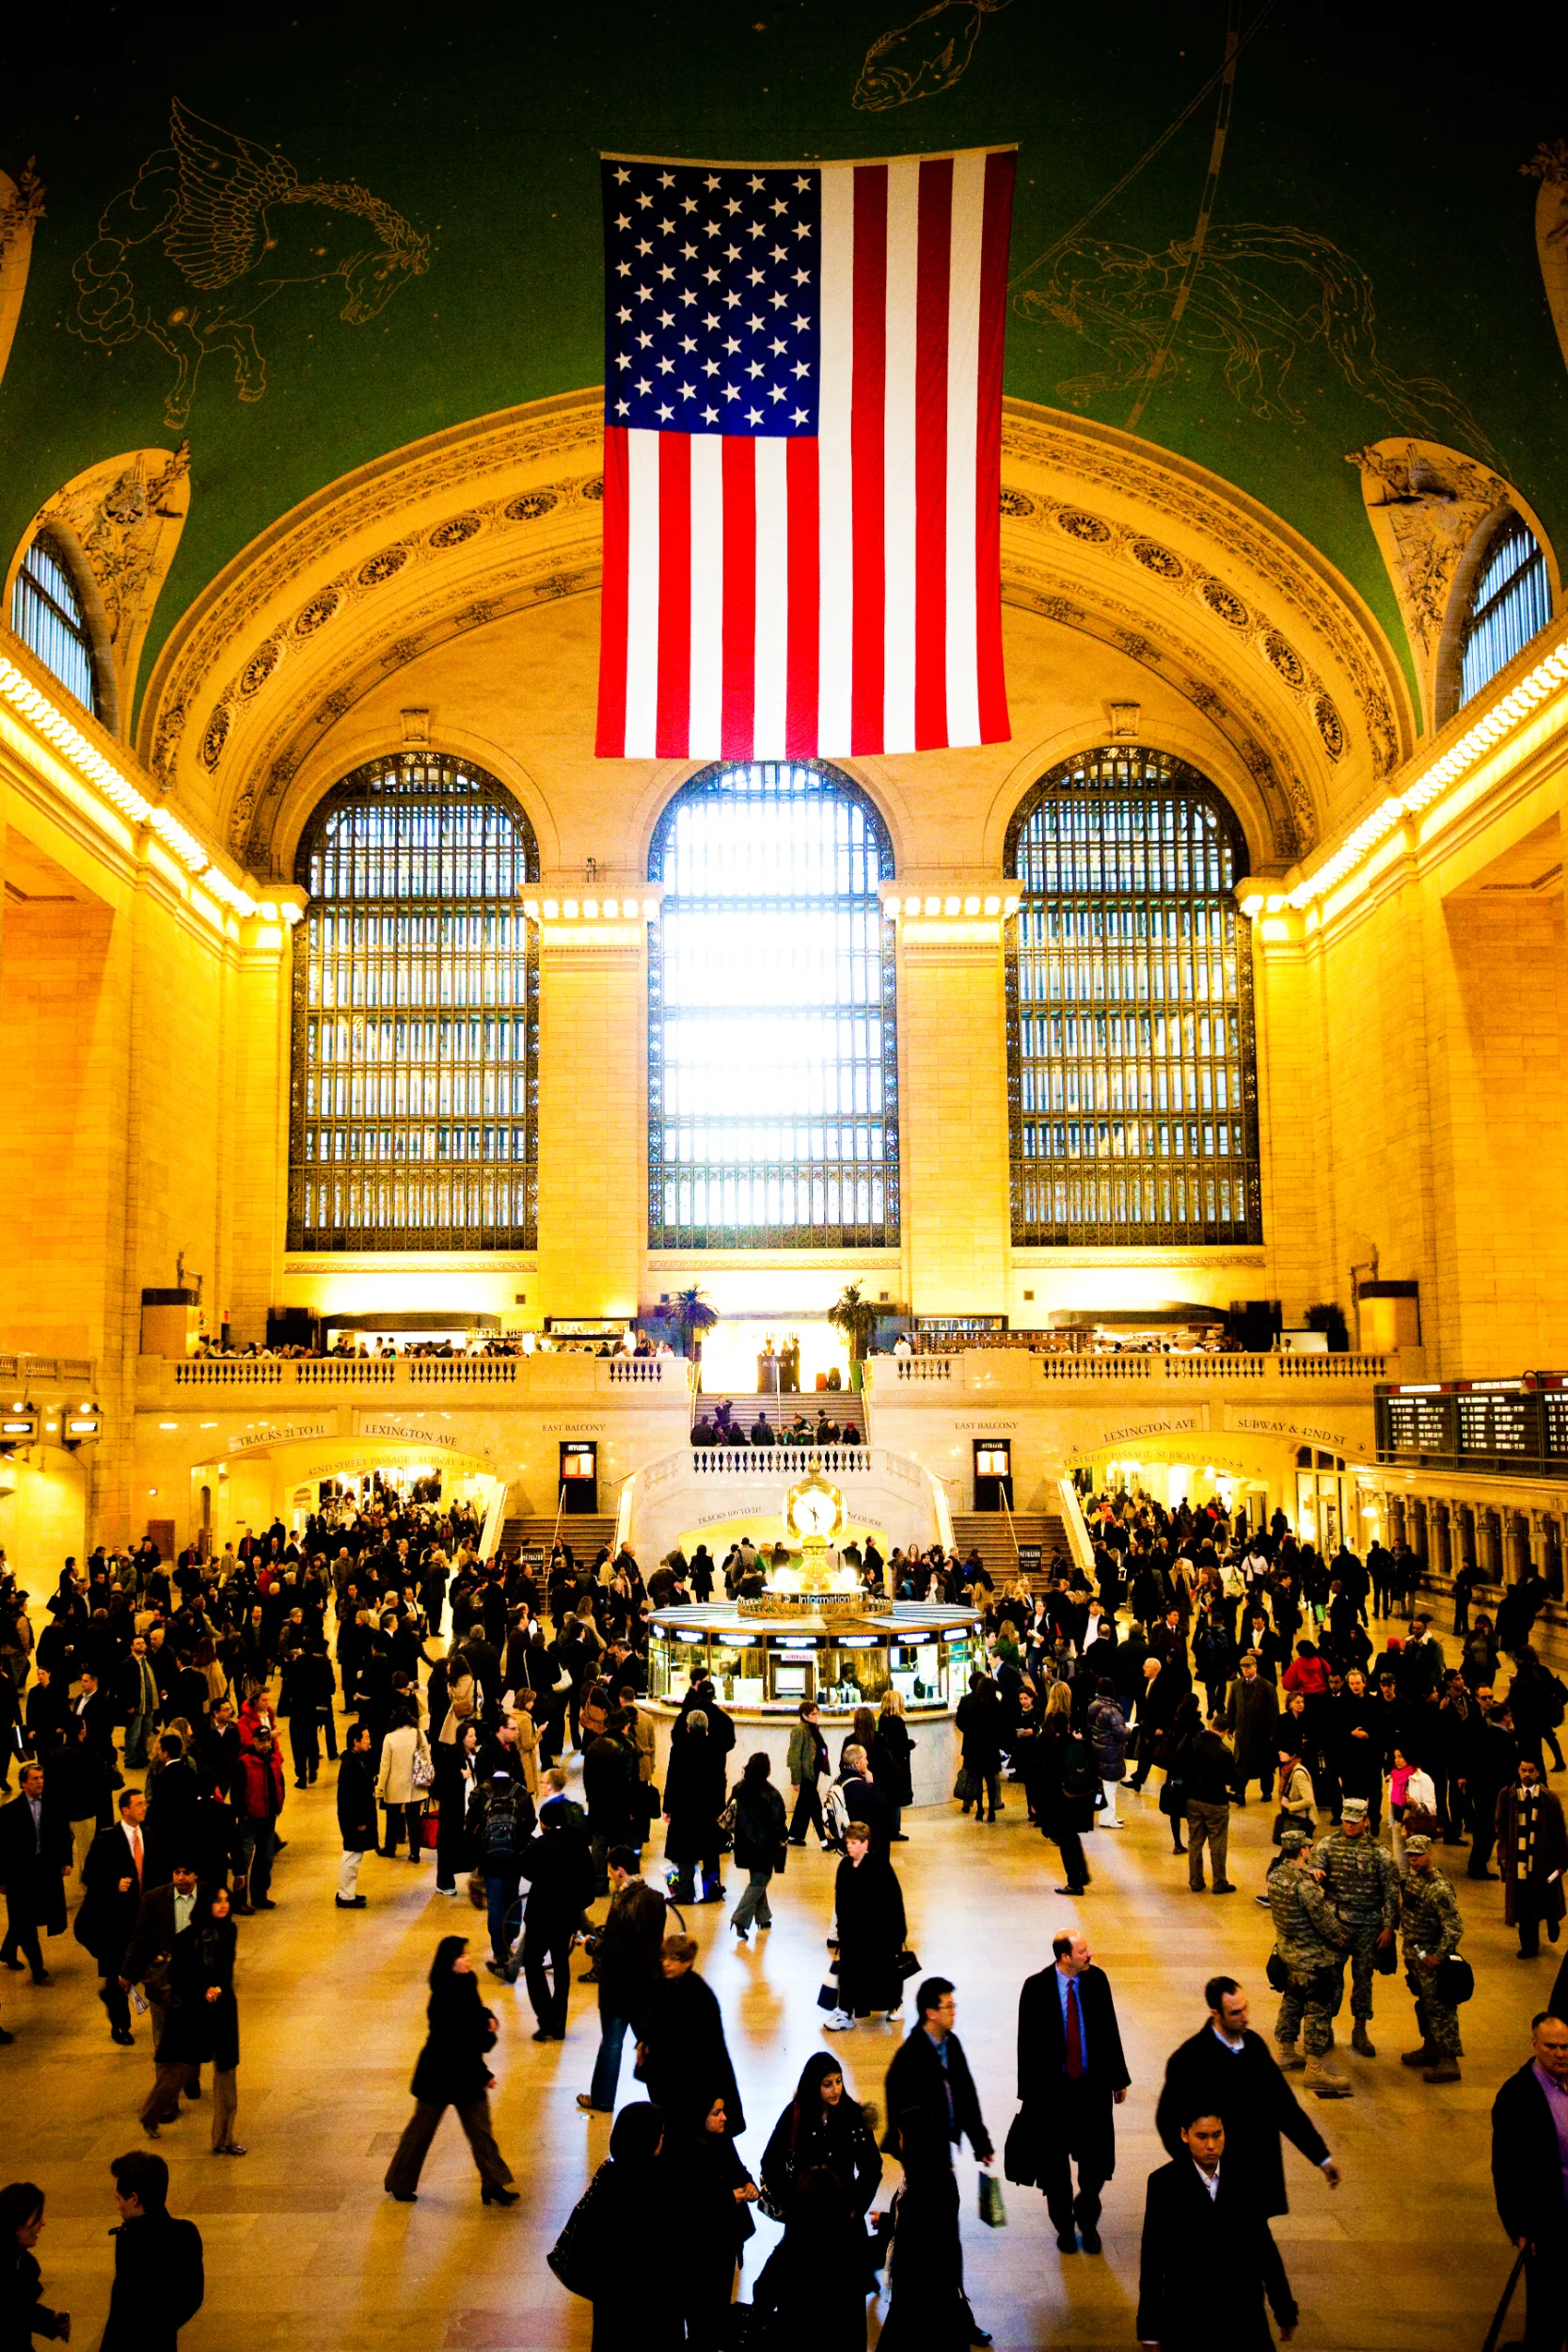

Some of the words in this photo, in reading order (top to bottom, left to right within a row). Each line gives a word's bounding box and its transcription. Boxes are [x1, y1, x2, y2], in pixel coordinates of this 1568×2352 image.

[365, 1423, 433, 1441] LEXINGTON
[436, 1435, 457, 1446] AVE
[542, 1423, 562, 1432] EAST
[565, 1423, 606, 1432] BALCONY
[955, 1422, 975, 1430] EAST
[978, 1422, 1019, 1430] BALCONY
[1103, 1421, 1172, 1442] LEXINGTON
[1176, 1419, 1196, 1429] AVE
[1238, 1419, 1286, 1431] SUBWAY
[1289, 1424, 1298, 1434] &
[1301, 1427, 1331, 1441] 42ND
[1334, 1435, 1347, 1445] ST
[238, 1429, 282, 1446] TRACKS
[285, 1428, 294, 1438] 21
[297, 1425, 313, 1436] TO
[316, 1424, 325, 1434] 11
[309, 1464, 333, 1475] 42ND
[334, 1458, 368, 1469] STREET
[371, 1455, 410, 1465] PASSAGE
[418, 1455, 456, 1466] SUBWAY
[1073, 1452, 1108, 1465] STREET
[1111, 1450, 1151, 1459] PASSAGE
[1157, 1451, 1196, 1461] SUBWAY
[698, 1512, 726, 1524] TRACKS
[799, 1594, 850, 1604] Information
